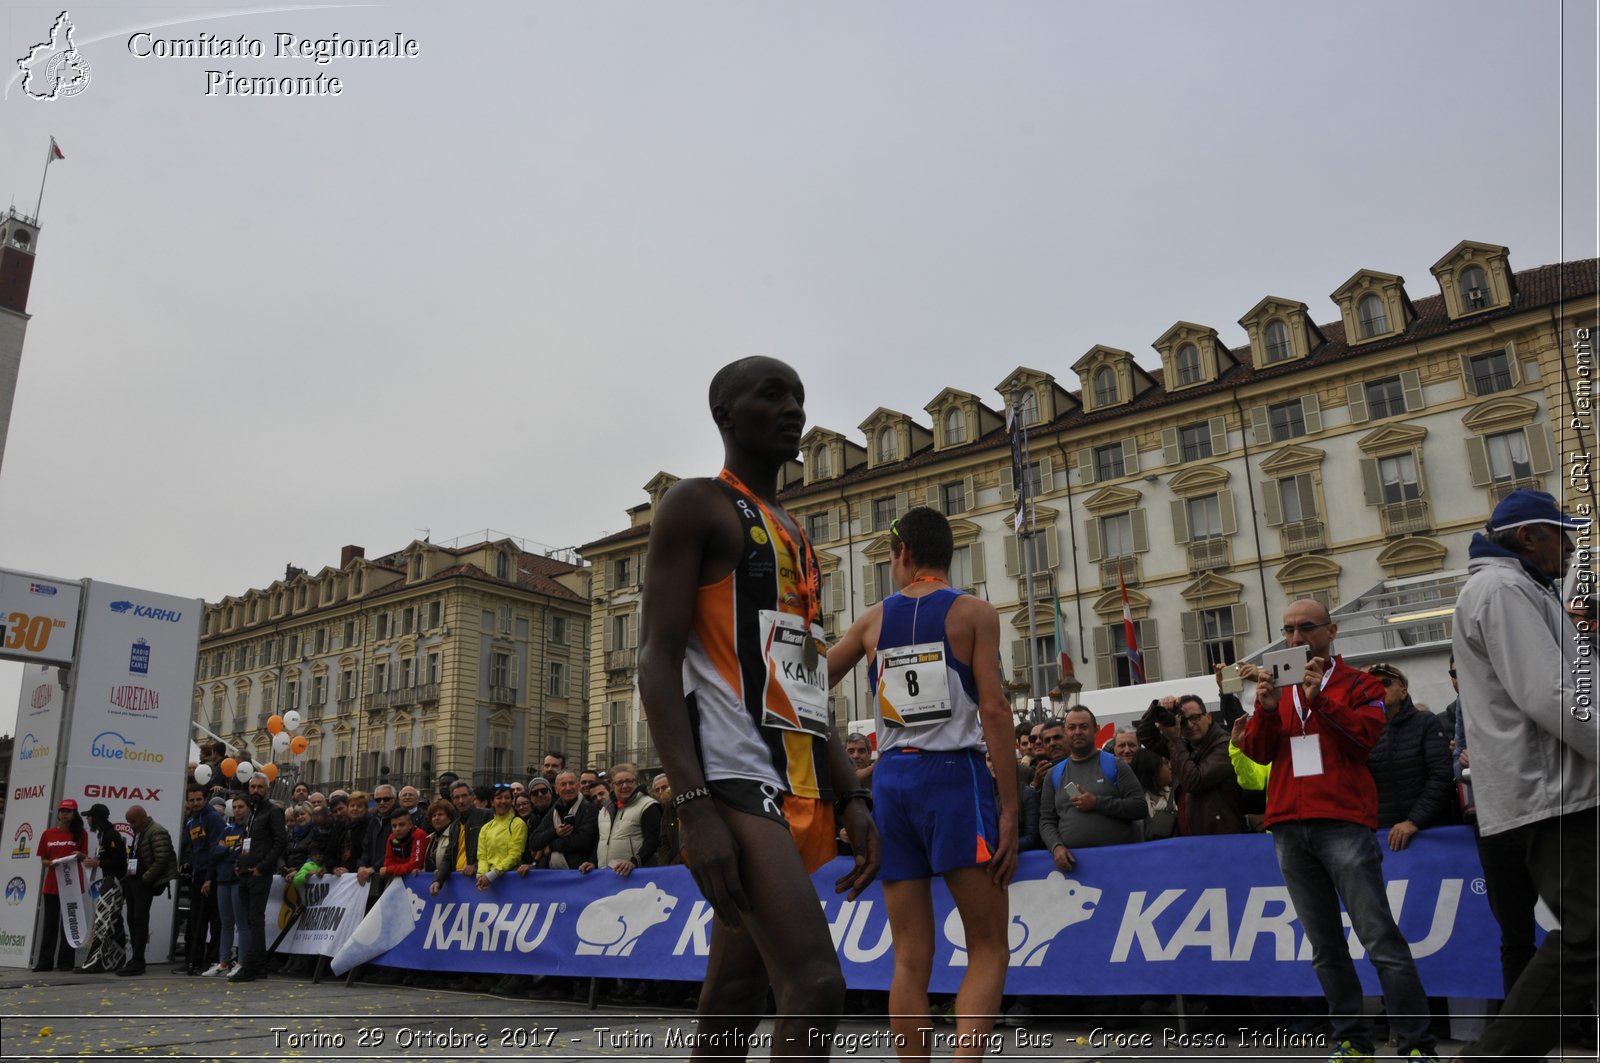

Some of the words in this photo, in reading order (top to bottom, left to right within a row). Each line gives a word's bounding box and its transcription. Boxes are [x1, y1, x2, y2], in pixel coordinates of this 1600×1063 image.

[133, 605, 182, 623] KARHU
[5, 612, 53, 652] 30
[131, 654, 149, 663] MONTE
[132, 647, 149, 656] RADIO
[918, 653, 939, 663] Torino
[131, 661, 148, 670] CARLO
[905, 670, 920, 697] 8
[110, 686, 160, 711] LAURETANA
[91, 743, 164, 763] bluetorino
[14, 784, 46, 800] GIMAX
[84, 784, 161, 801] GIMAX
[66, 902, 80, 940] Maratona
[423, 902, 559, 953] KARHU
[672, 900, 893, 963] KHU
